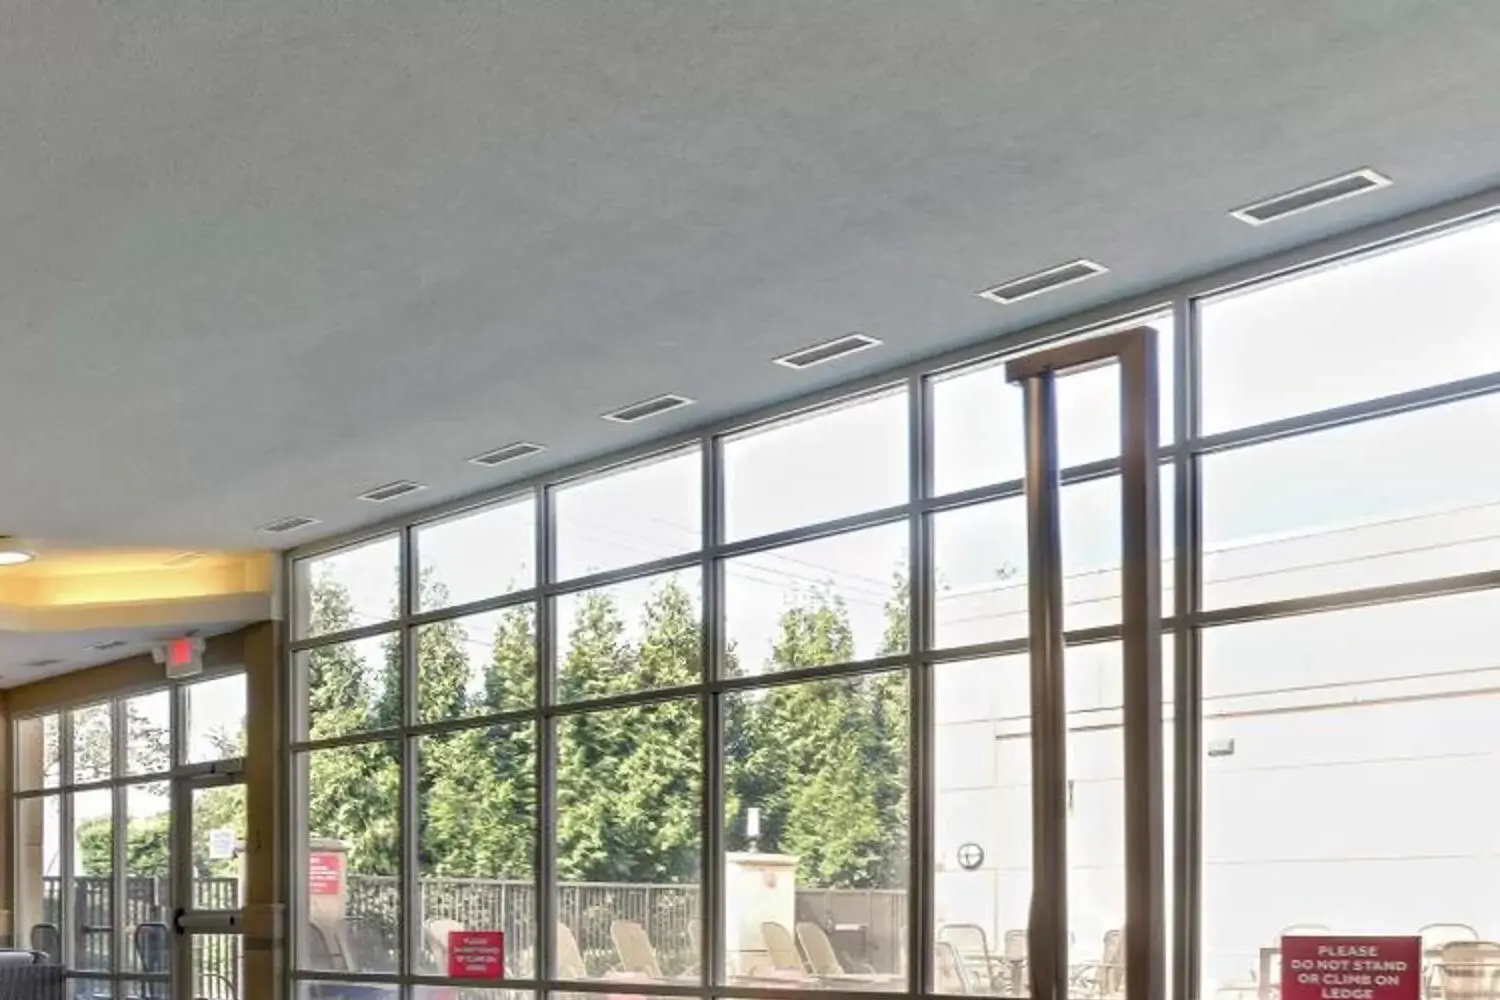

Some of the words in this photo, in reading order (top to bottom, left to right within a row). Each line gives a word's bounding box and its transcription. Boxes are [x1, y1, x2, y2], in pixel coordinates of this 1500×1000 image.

[1317, 945, 1379, 957] PLEASE
[1290, 959, 1314, 970] DO
[1317, 960, 1350, 971] NOT
[1353, 960, 1408, 972] STAND
[1297, 973, 1319, 984] OR
[1322, 974, 1373, 986] CLIMB
[1375, 975, 1400, 987] ON
[1321, 988, 1373, 1000] LEDGE
